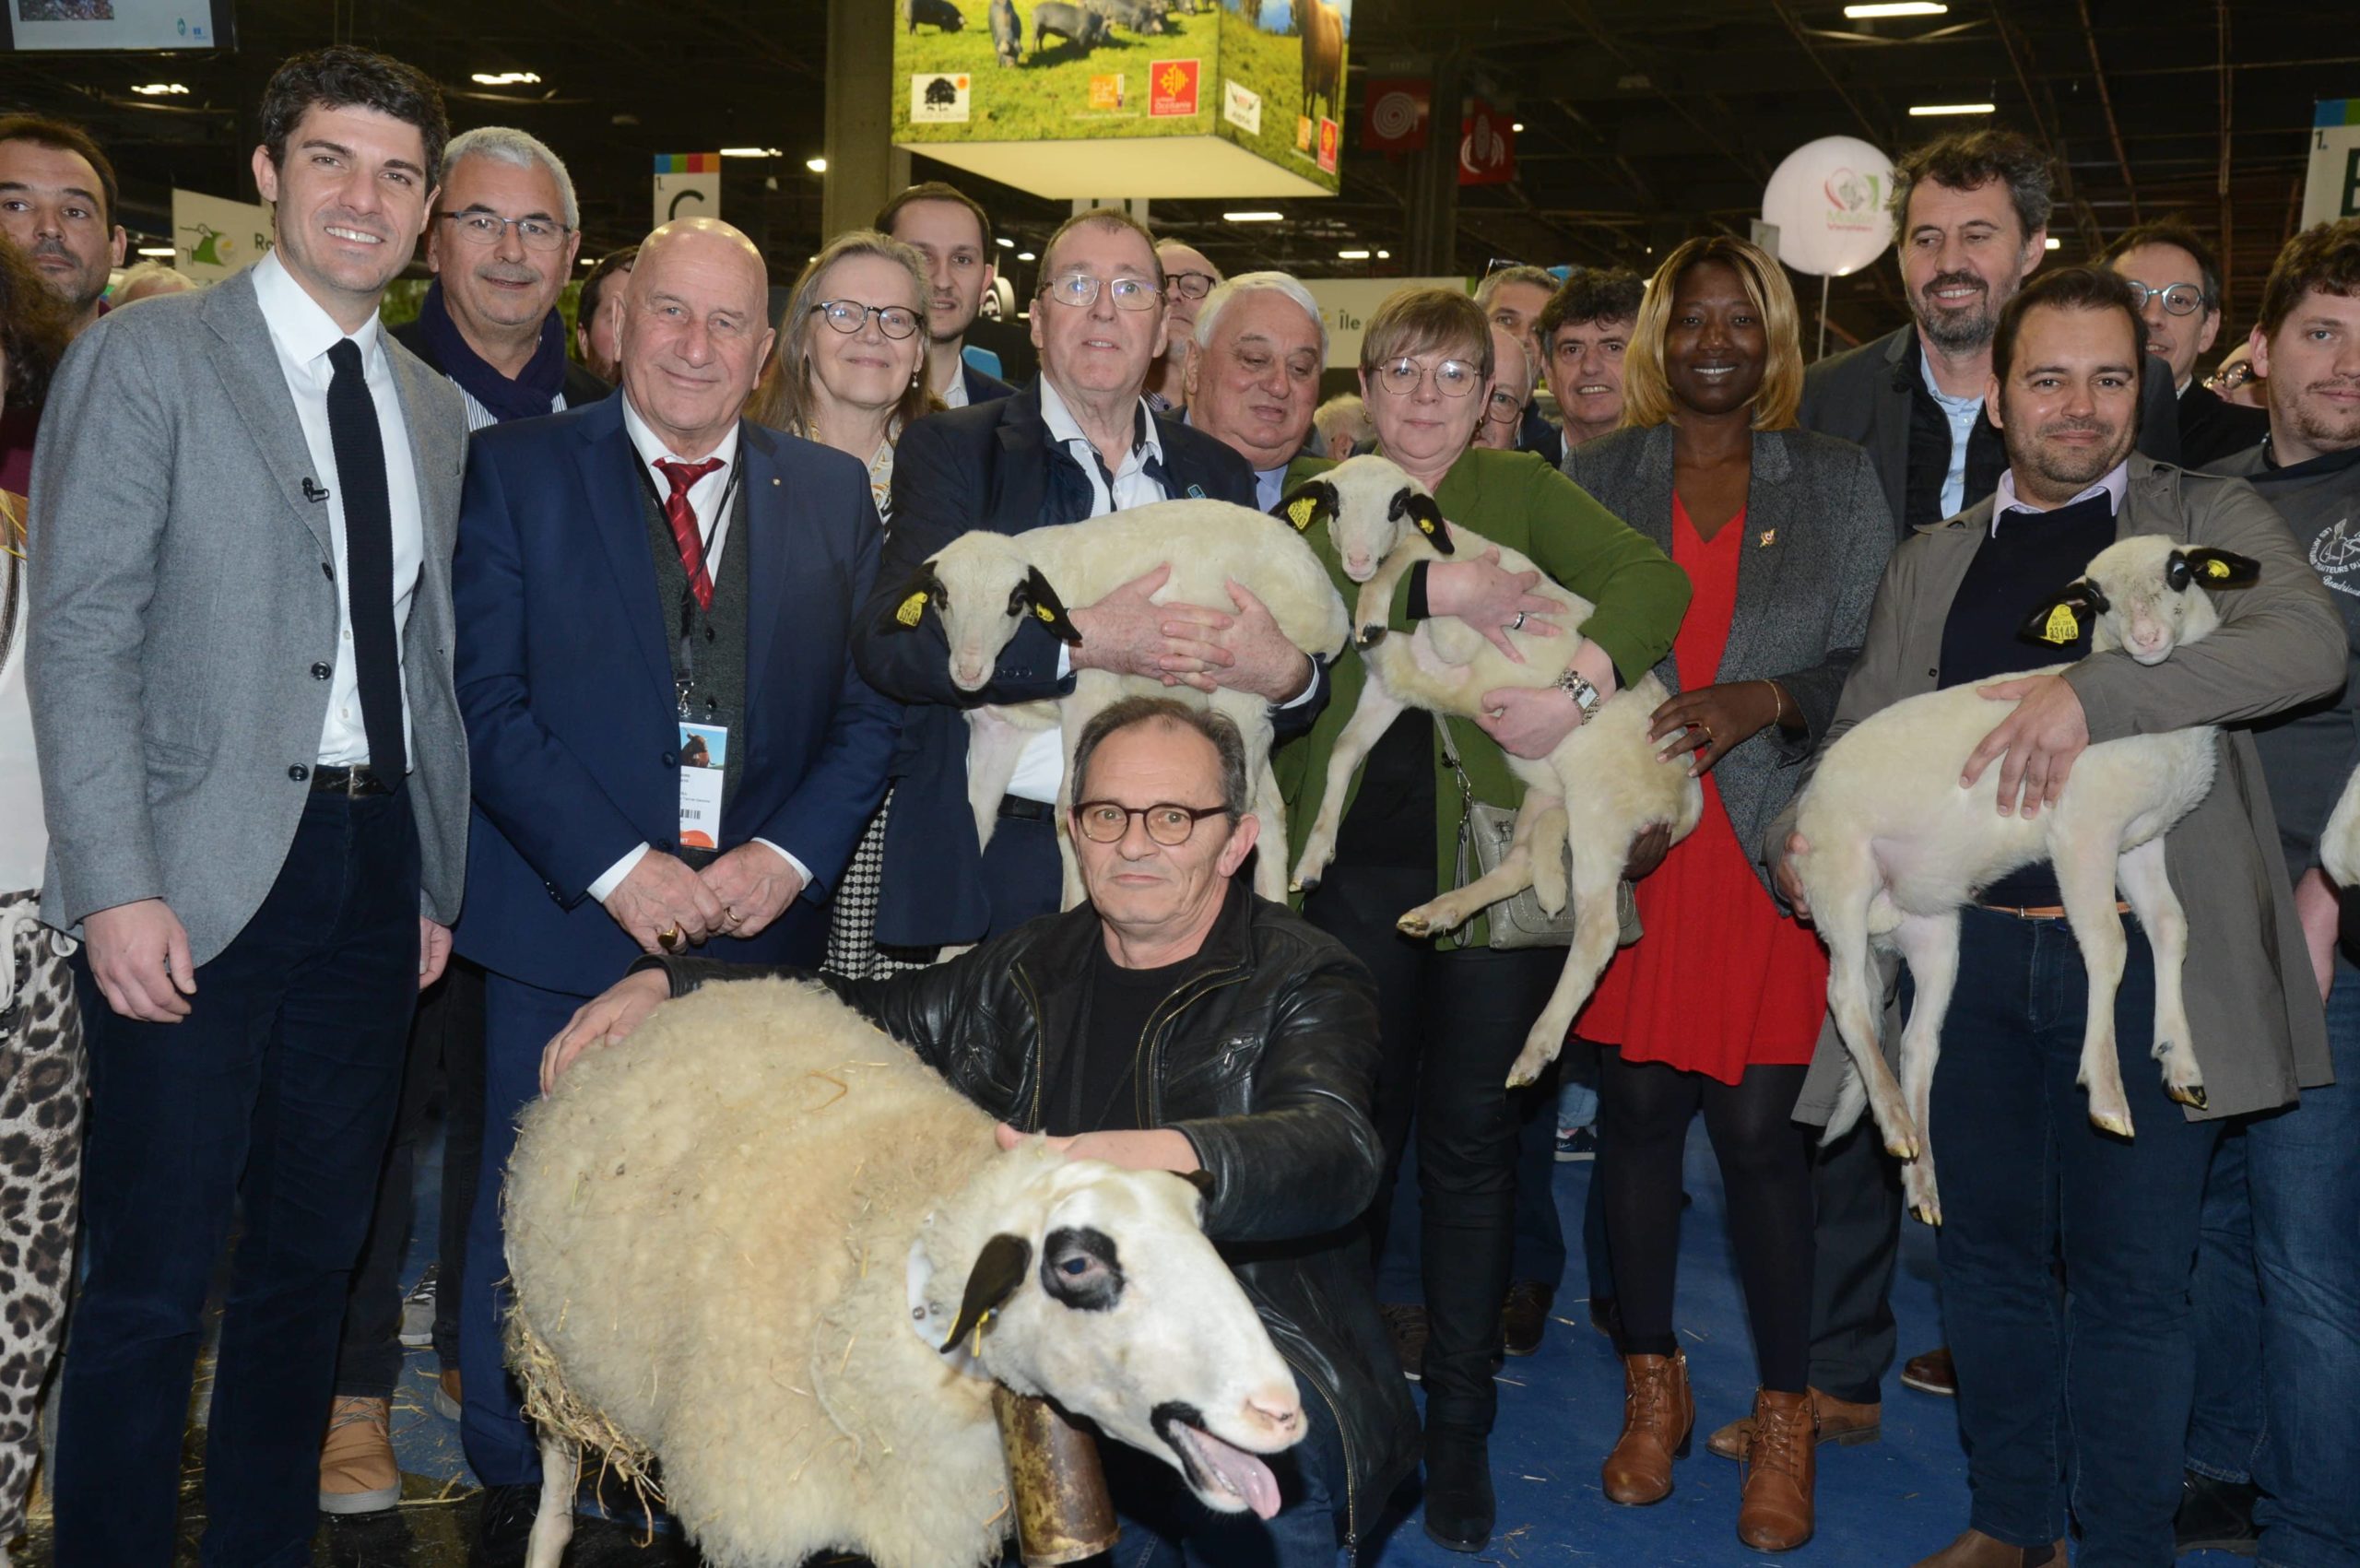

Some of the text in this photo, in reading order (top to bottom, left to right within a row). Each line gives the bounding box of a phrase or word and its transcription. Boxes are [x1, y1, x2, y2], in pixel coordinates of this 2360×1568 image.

[1339, 309, 1361, 331] Île
[2319, 527, 2332, 537] LES
[2048, 626, 2077, 640] 33148
